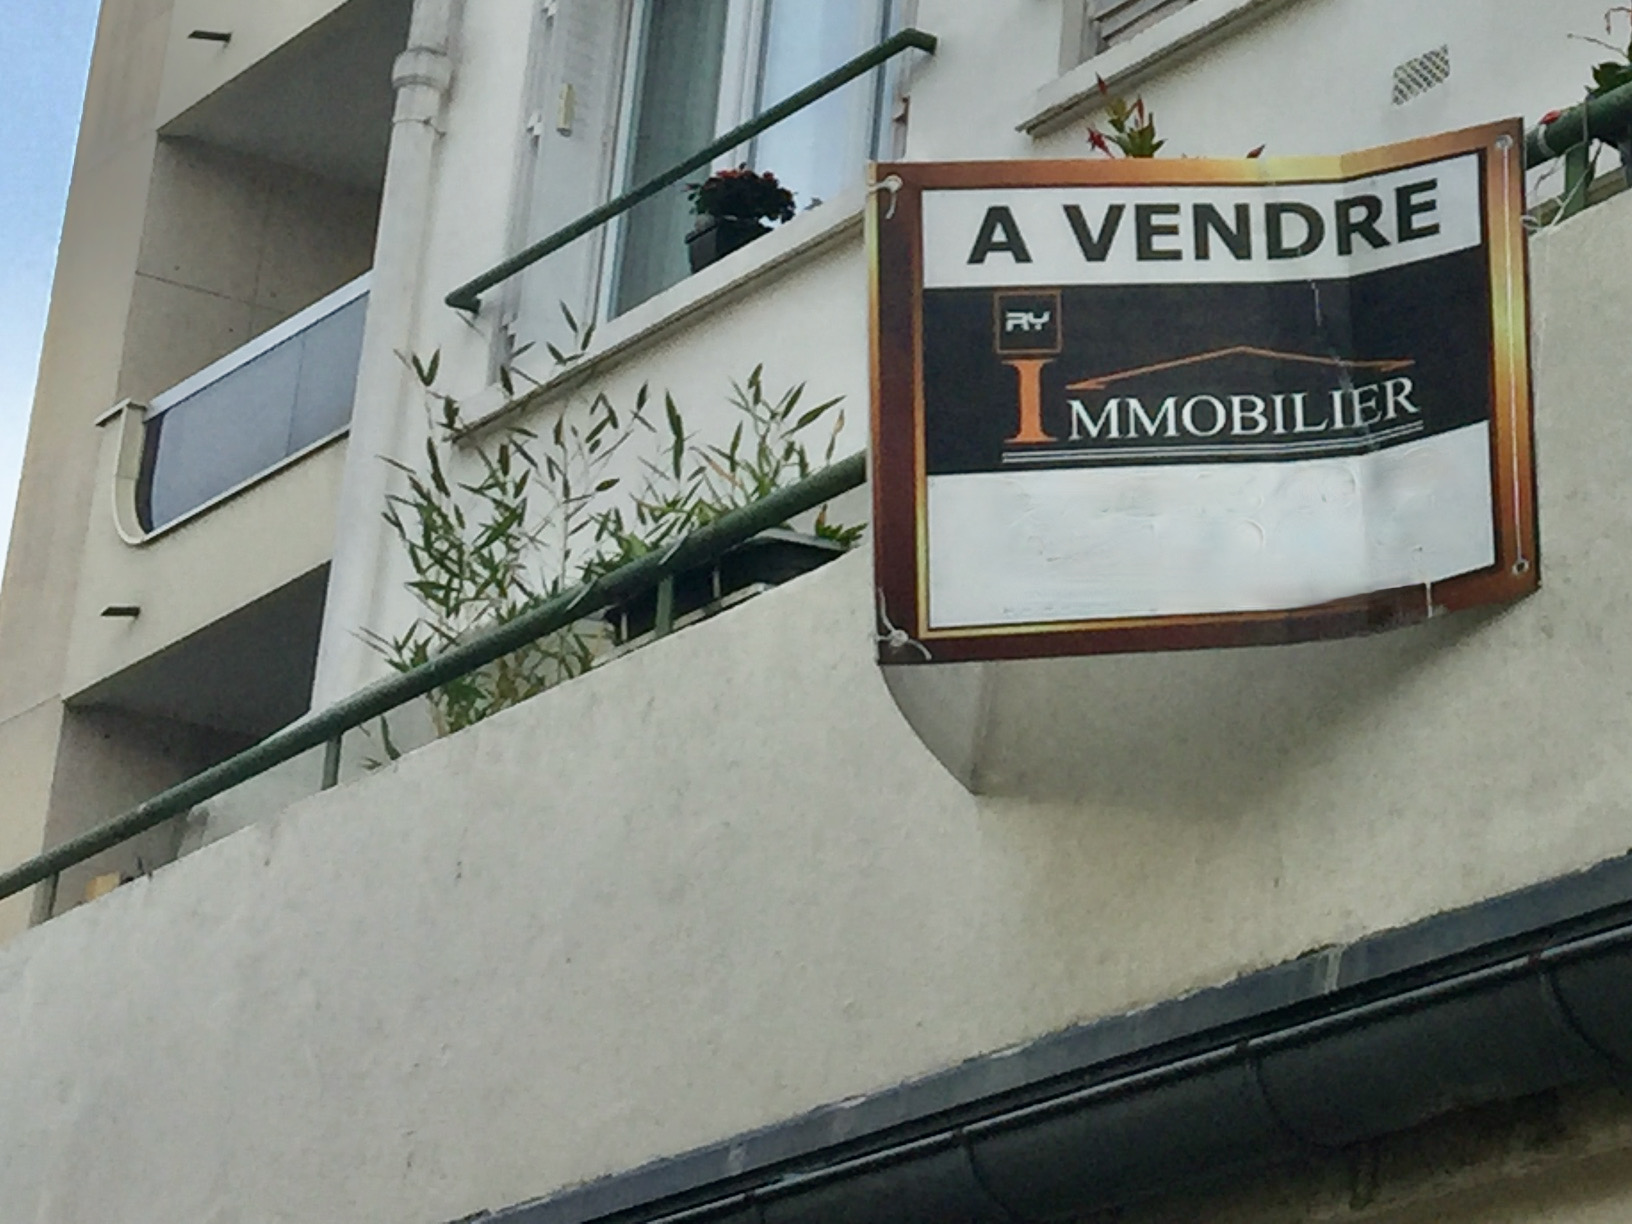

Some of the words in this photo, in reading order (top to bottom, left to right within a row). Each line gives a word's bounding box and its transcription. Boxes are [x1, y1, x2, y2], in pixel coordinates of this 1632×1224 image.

[967, 205, 1032, 264] A
[1064, 178, 1440, 263] VENDRE
[1003, 358, 1419, 443] IMMOBILIER
